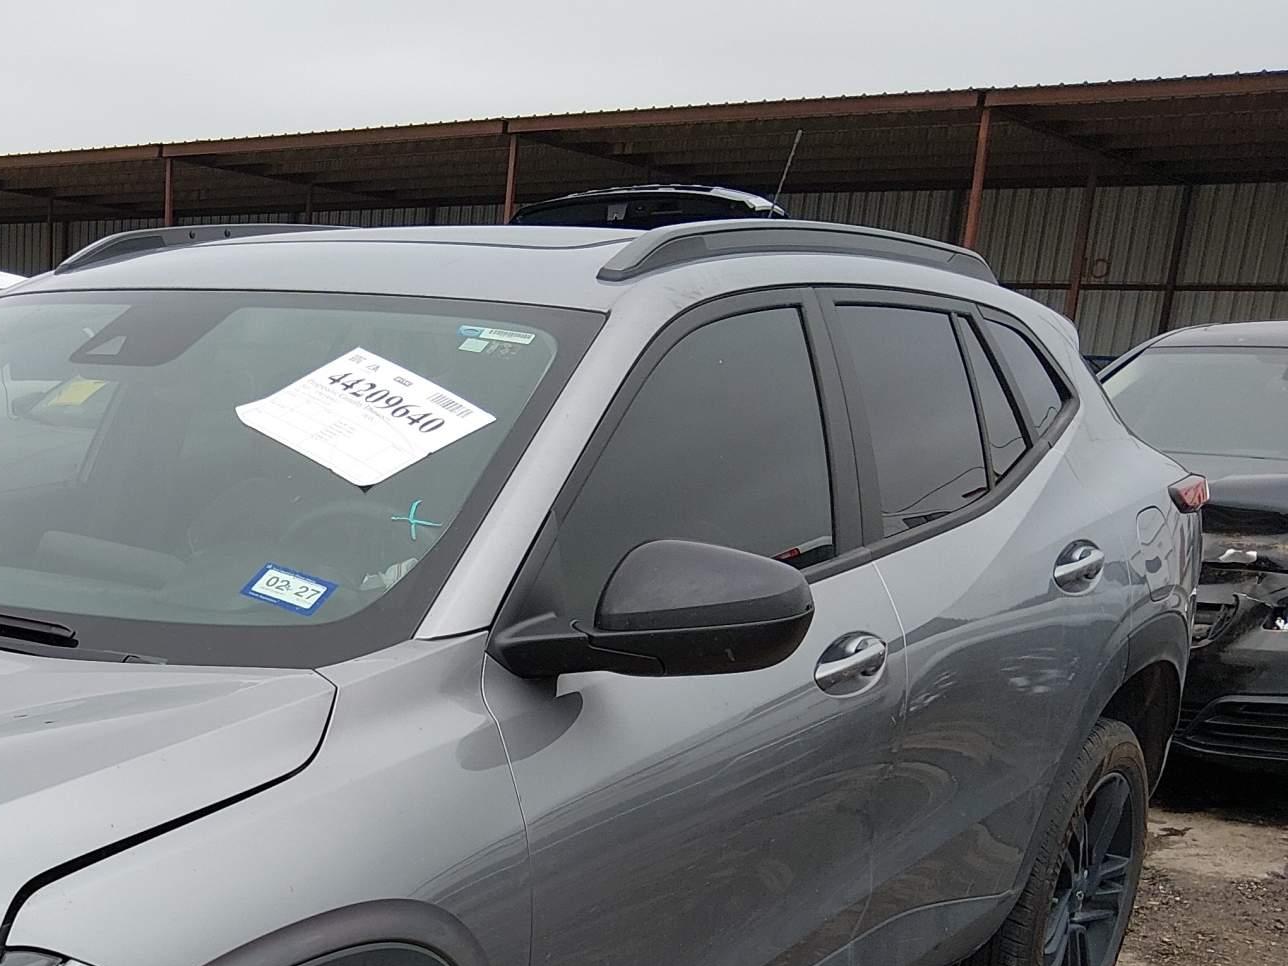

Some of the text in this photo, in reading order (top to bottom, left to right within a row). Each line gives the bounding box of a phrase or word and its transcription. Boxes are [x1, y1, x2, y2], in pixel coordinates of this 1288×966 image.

[328, 372, 445, 433] 44209640
[266, 576, 290, 591] 02
[294, 586, 321, 599] 27
